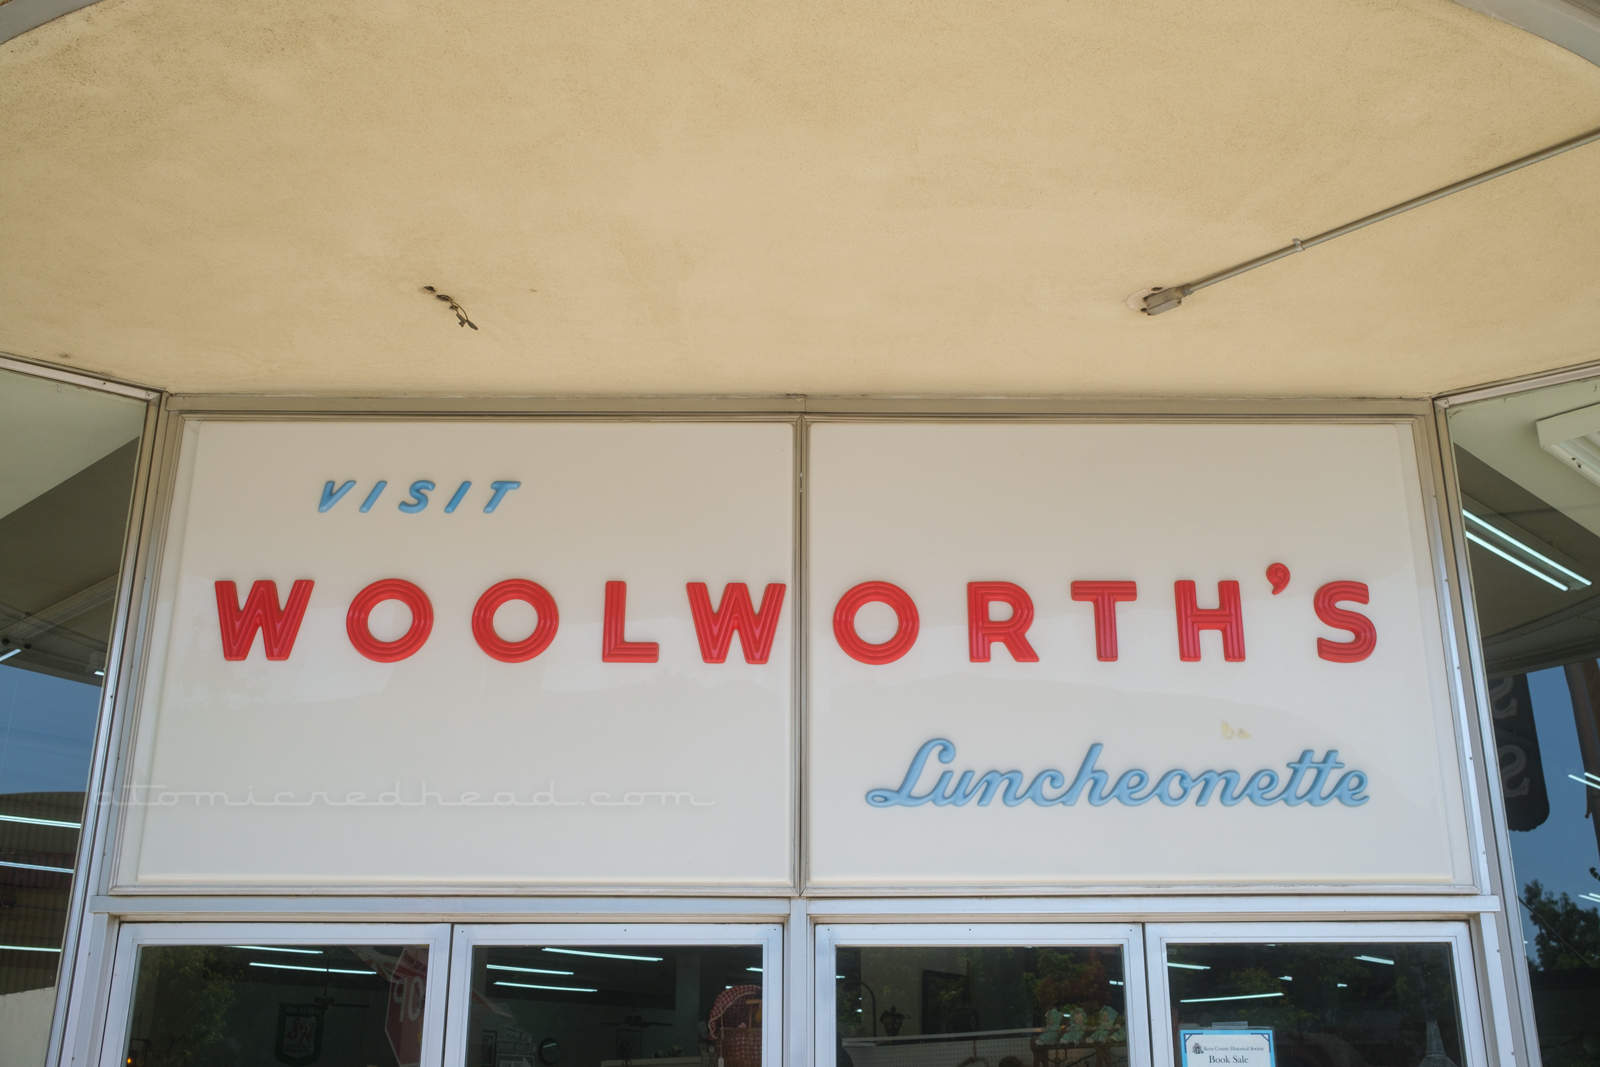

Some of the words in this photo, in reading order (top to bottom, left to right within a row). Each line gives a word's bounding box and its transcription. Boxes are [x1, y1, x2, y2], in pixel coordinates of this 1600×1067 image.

[317, 480, 521, 514] VISIT
[214, 562, 1377, 665] WOOLWORTH'S
[865, 738, 1371, 808] Luncheonette
[1209, 1055, 1230, 1064] Book
[1232, 1055, 1249, 1064] Sale
